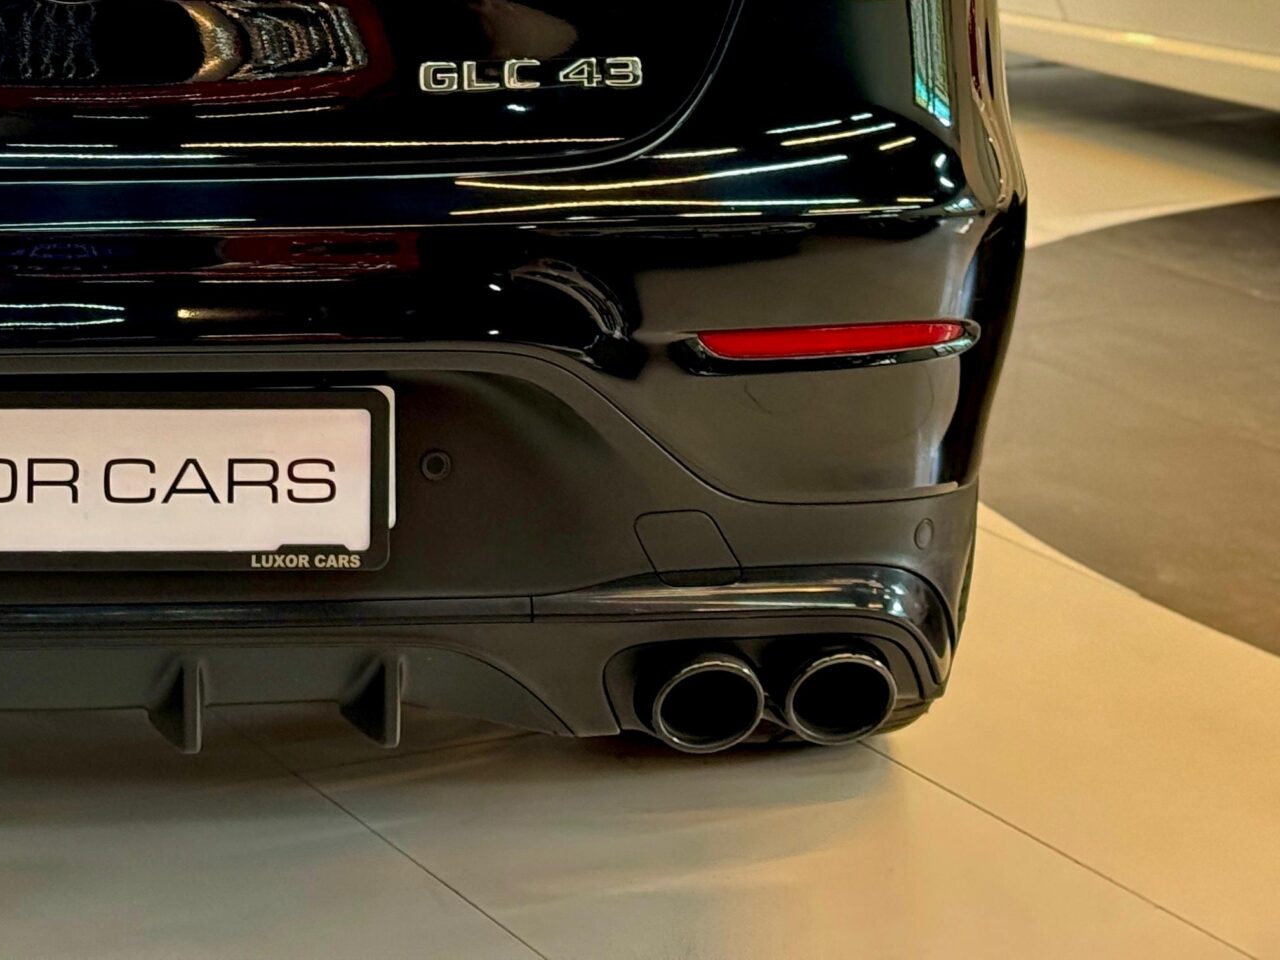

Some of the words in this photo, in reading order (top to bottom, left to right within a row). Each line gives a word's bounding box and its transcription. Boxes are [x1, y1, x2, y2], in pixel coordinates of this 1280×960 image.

[419, 59, 541, 91] GLC
[558, 56, 643, 88] 43
[103, 457, 337, 504] CARS
[250, 554, 310, 569] LUXOR
[313, 554, 361, 569] CARS
